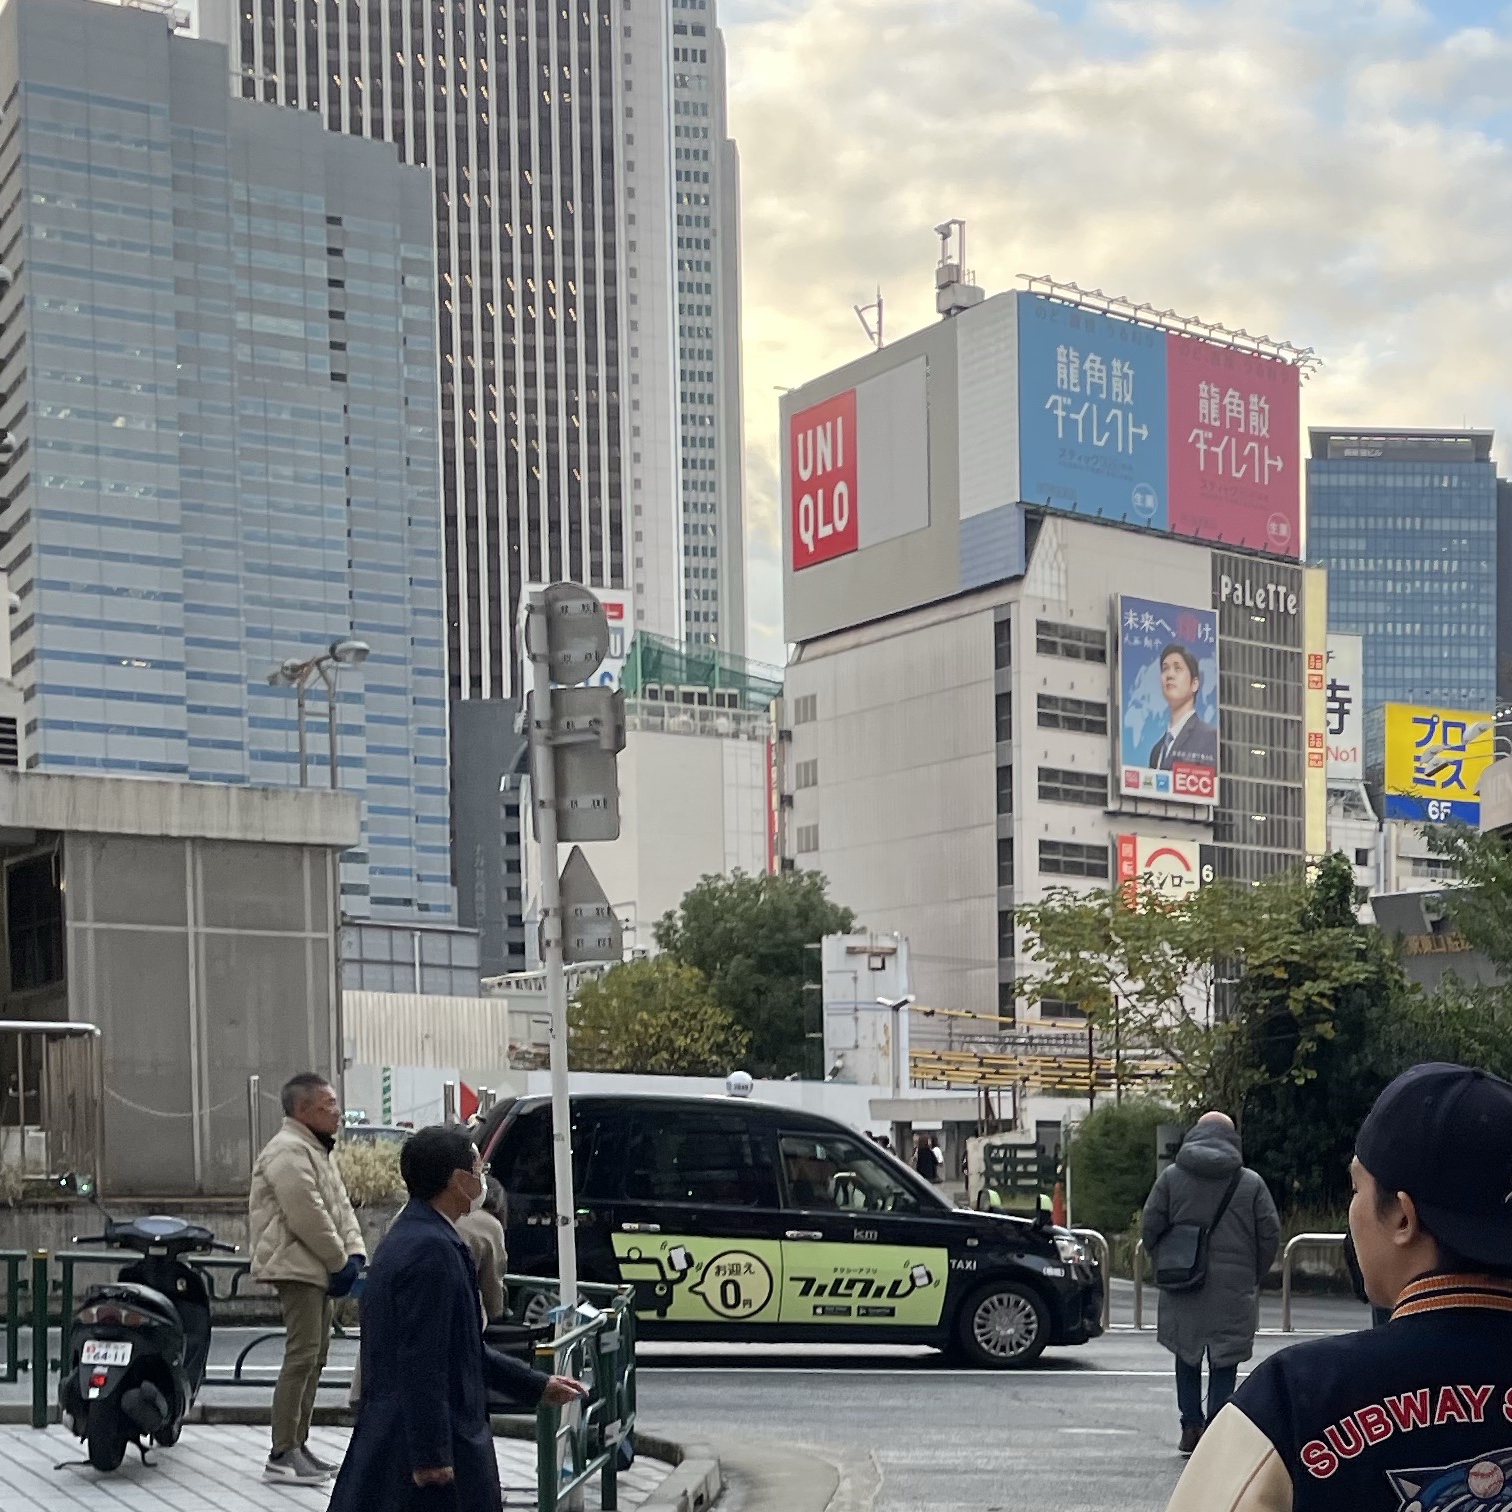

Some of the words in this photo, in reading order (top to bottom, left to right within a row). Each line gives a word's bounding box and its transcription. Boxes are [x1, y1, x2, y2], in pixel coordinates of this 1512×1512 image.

[1056, 344, 1134, 405] 龍角散
[1045, 394, 1149, 455] ダイレクト
[1198, 380, 1270, 438] 龍角散
[798, 416, 843, 482] UNI
[1188, 428, 1284, 485] ダイレクト
[799, 480, 849, 554] QLO
[1412, 713, 1467, 752] プロ
[1175, 773, 1212, 794] ECC
[853, 1228, 878, 1240] km
[714, 1262, 756, 1277] お迎え
[949, 1258, 978, 1271] TAXI
[1300, 1384, 1495, 1479] SUBWAY
